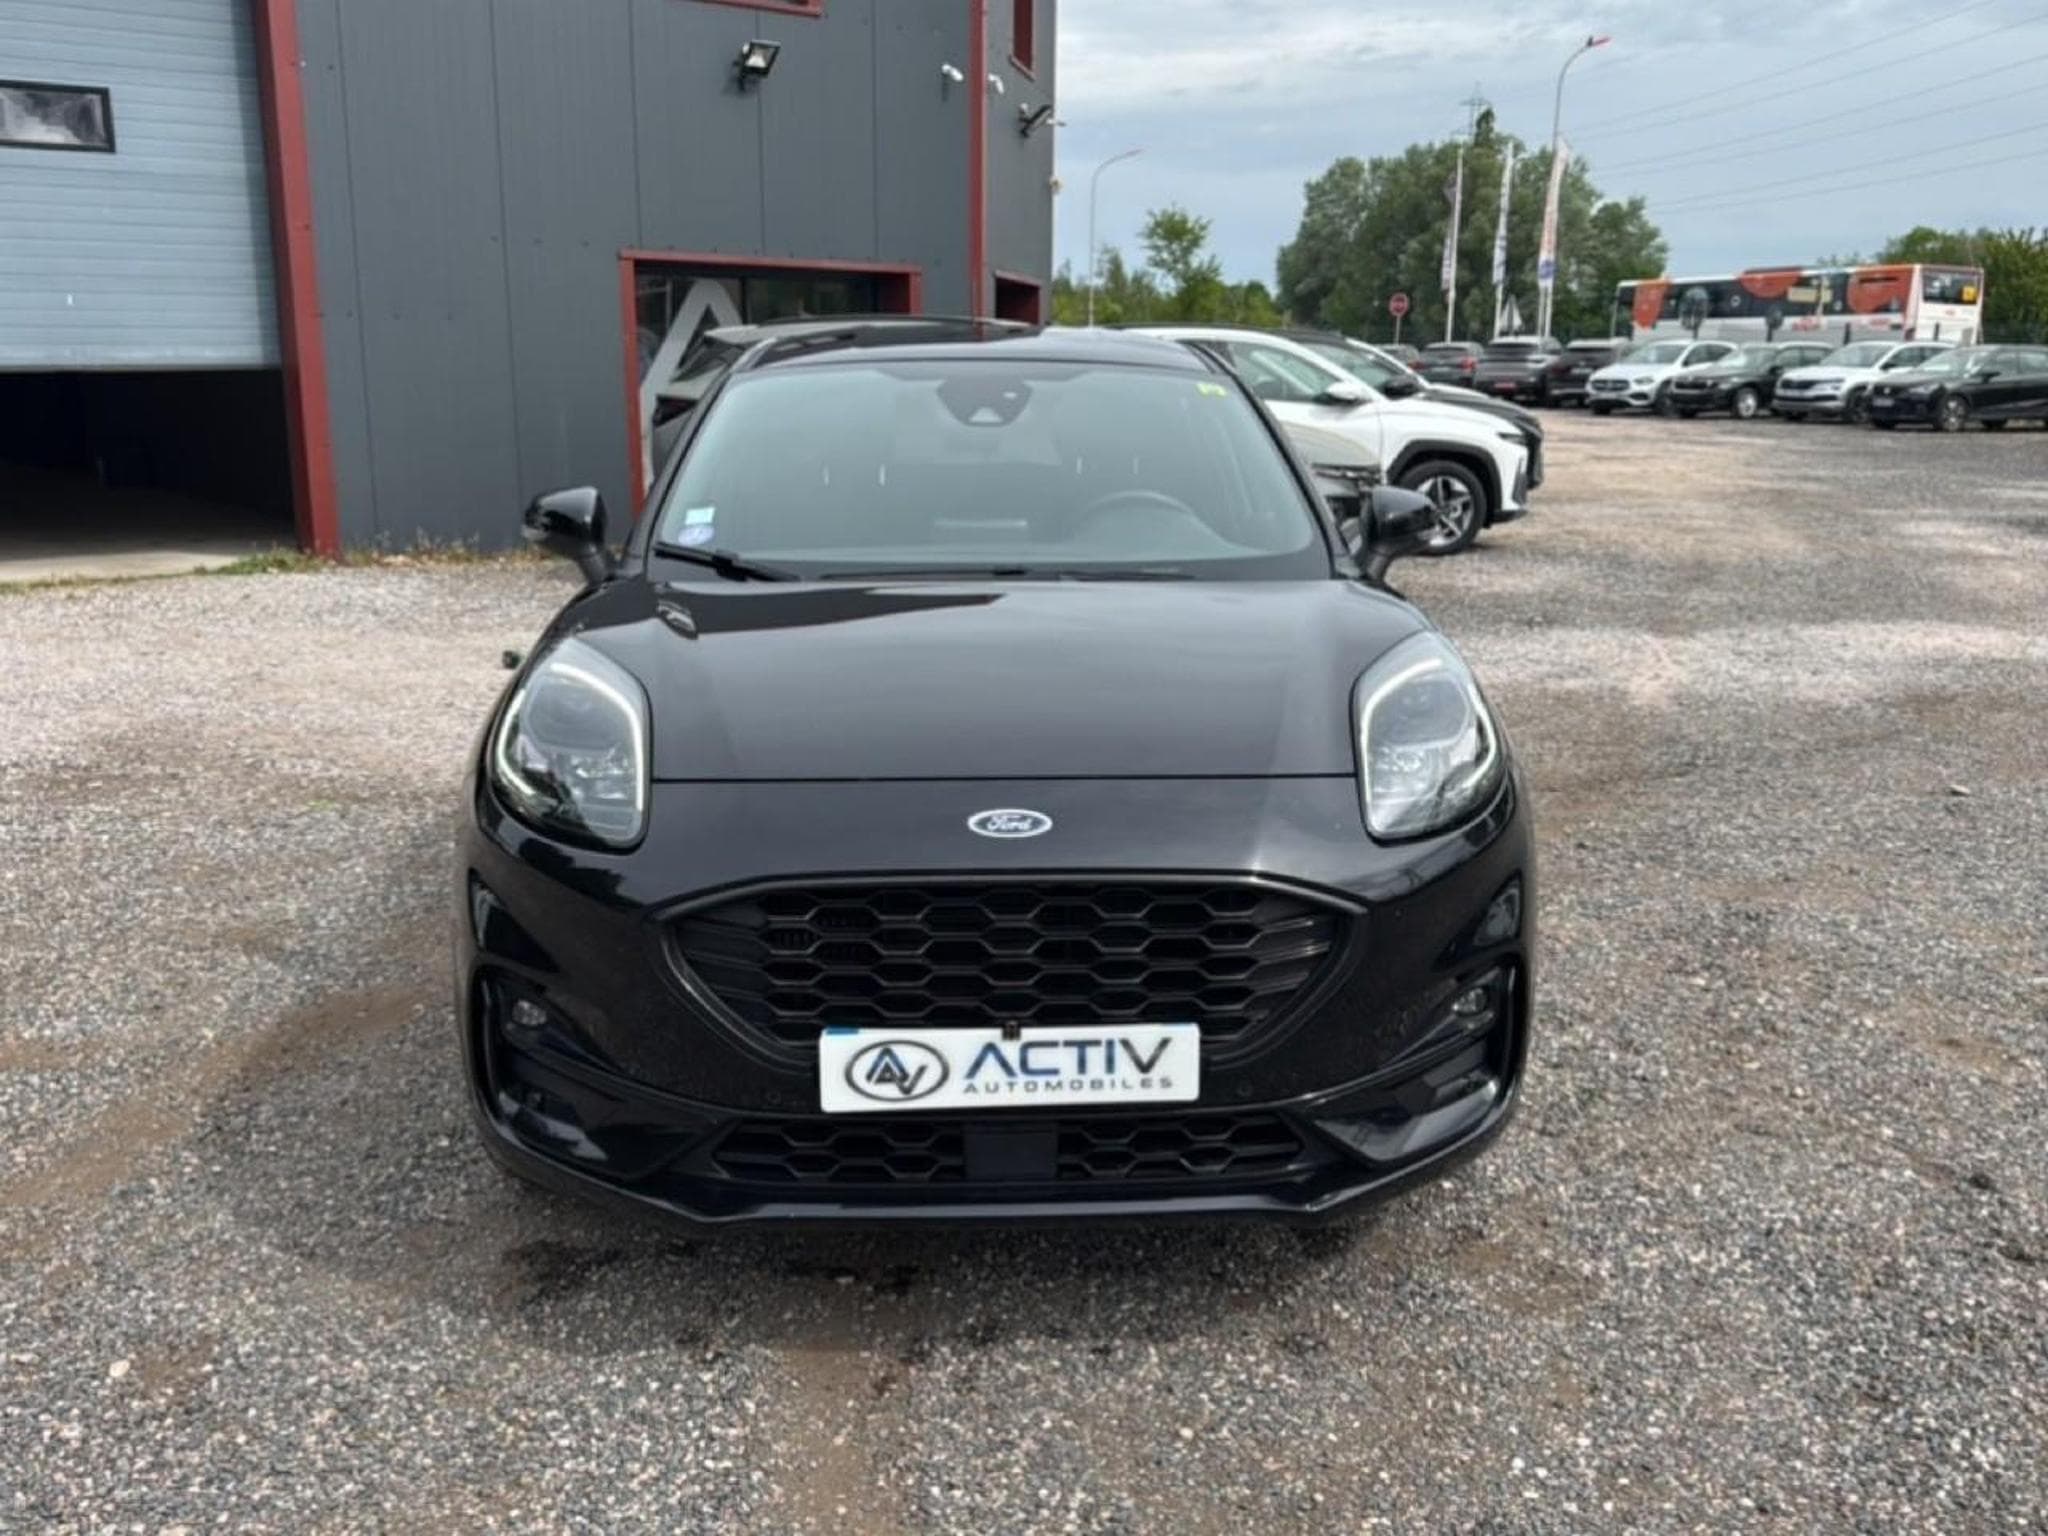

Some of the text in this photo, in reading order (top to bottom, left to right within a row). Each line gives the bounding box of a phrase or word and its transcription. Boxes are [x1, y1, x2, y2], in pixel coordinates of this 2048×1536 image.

[986, 814, 1033, 832] Ford
[965, 1037, 1172, 1079] ACTIV
[963, 1076, 1174, 1094] AUTOMOBILES
